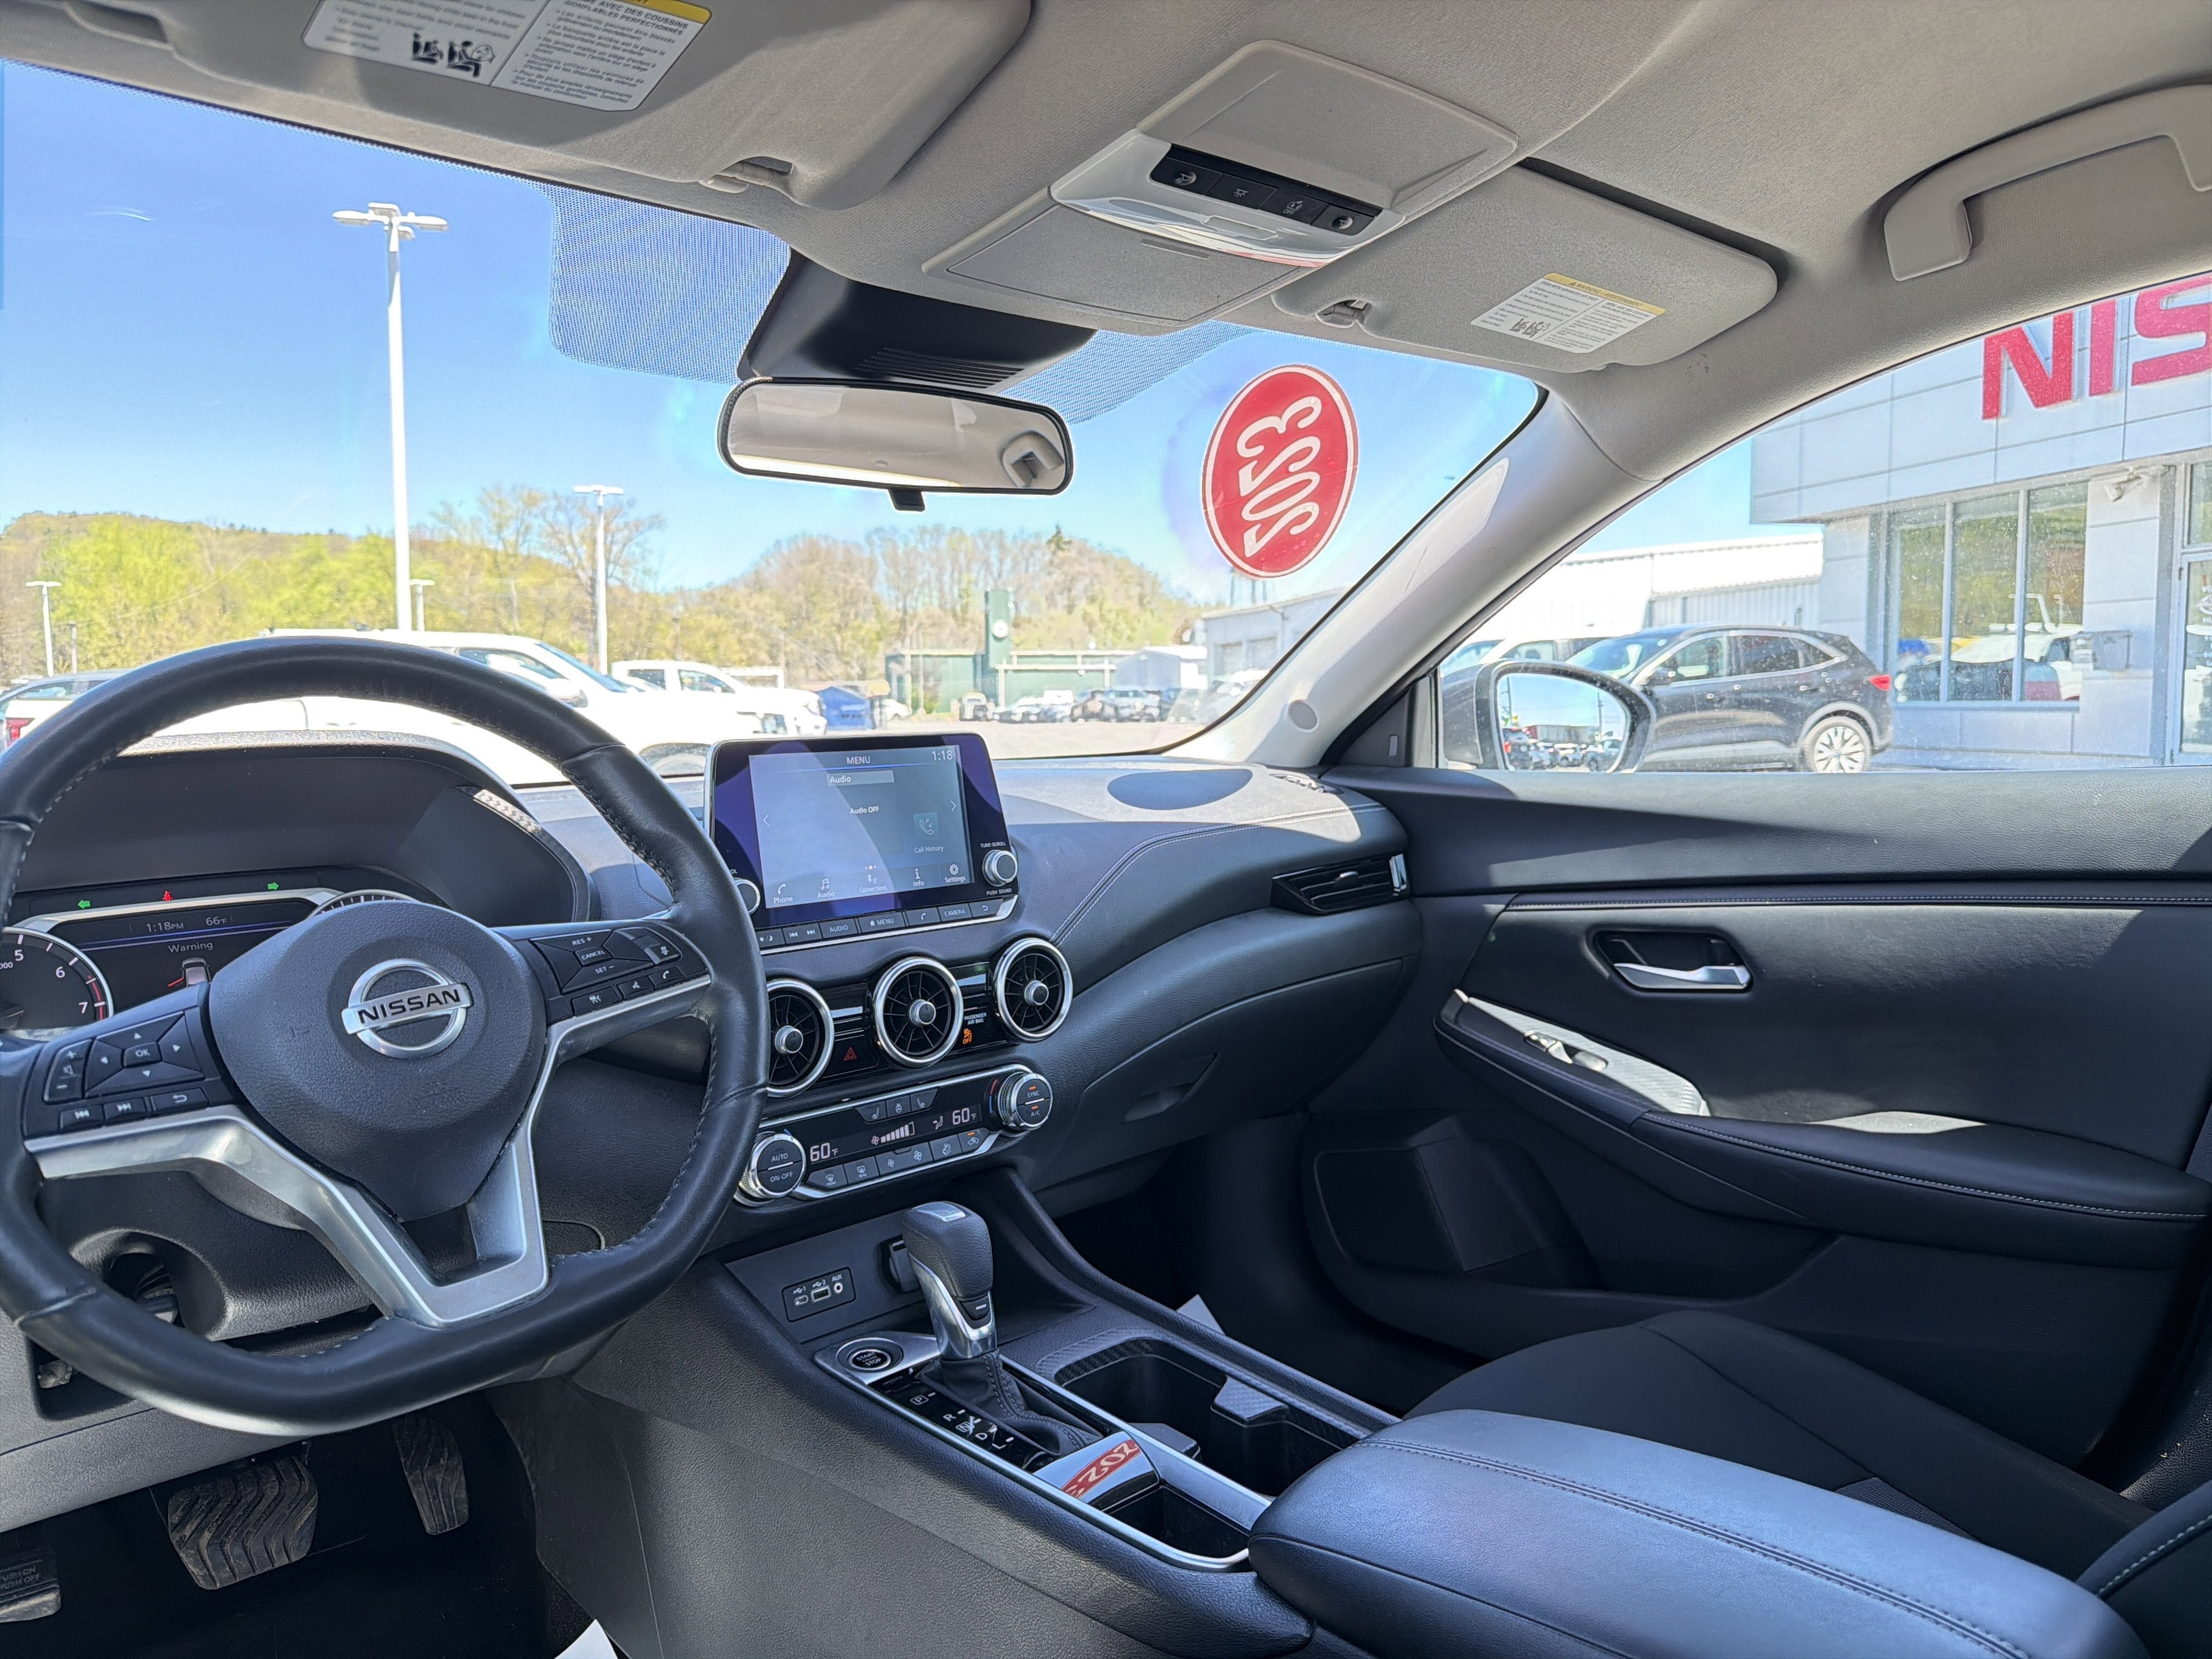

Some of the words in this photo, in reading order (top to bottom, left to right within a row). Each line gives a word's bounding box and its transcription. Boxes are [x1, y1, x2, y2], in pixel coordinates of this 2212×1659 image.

[564, 1, 619, 19] GONFLABLES
[600, 1, 623, 13] AVEC
[625, 8, 643, 17] DES
[645, 13, 689, 29] COUSSINS
[1982, 275, 2212, 421] NIS
[846, 755, 871, 765] MENU
[932, 749, 953, 761] 1:18
[830, 775, 851, 784] Audio
[850, 806, 867, 815] Audio
[925, 845, 944, 854] History
[945, 875, 966, 884] Settings
[859, 885, 888, 894] Connections
[168, 941, 213, 953] Warning
[572, 938, 585, 946] RES
[14, 949, 24, 962] 5
[582, 950, 606, 961] CANCEL
[56, 966, 65, 978] 6
[78, 1001, 88, 1014] 7
[358, 989, 461, 1024] NISSAN
[964, 1012, 987, 1020] PASSENGER
[136, 1048, 150, 1058] OK
[1027, 1090, 1040, 1098] SYNC
[771, 1153, 788, 1163] AUTO
[770, 1171, 794, 1183] ON-OFF
[832, 1274, 843, 1282] AUX
[856, 1352, 876, 1361] START
[865, 1357, 882, 1366] STOP
[943, 1414, 957, 1422] R
[975, 1432, 988, 1441] D
